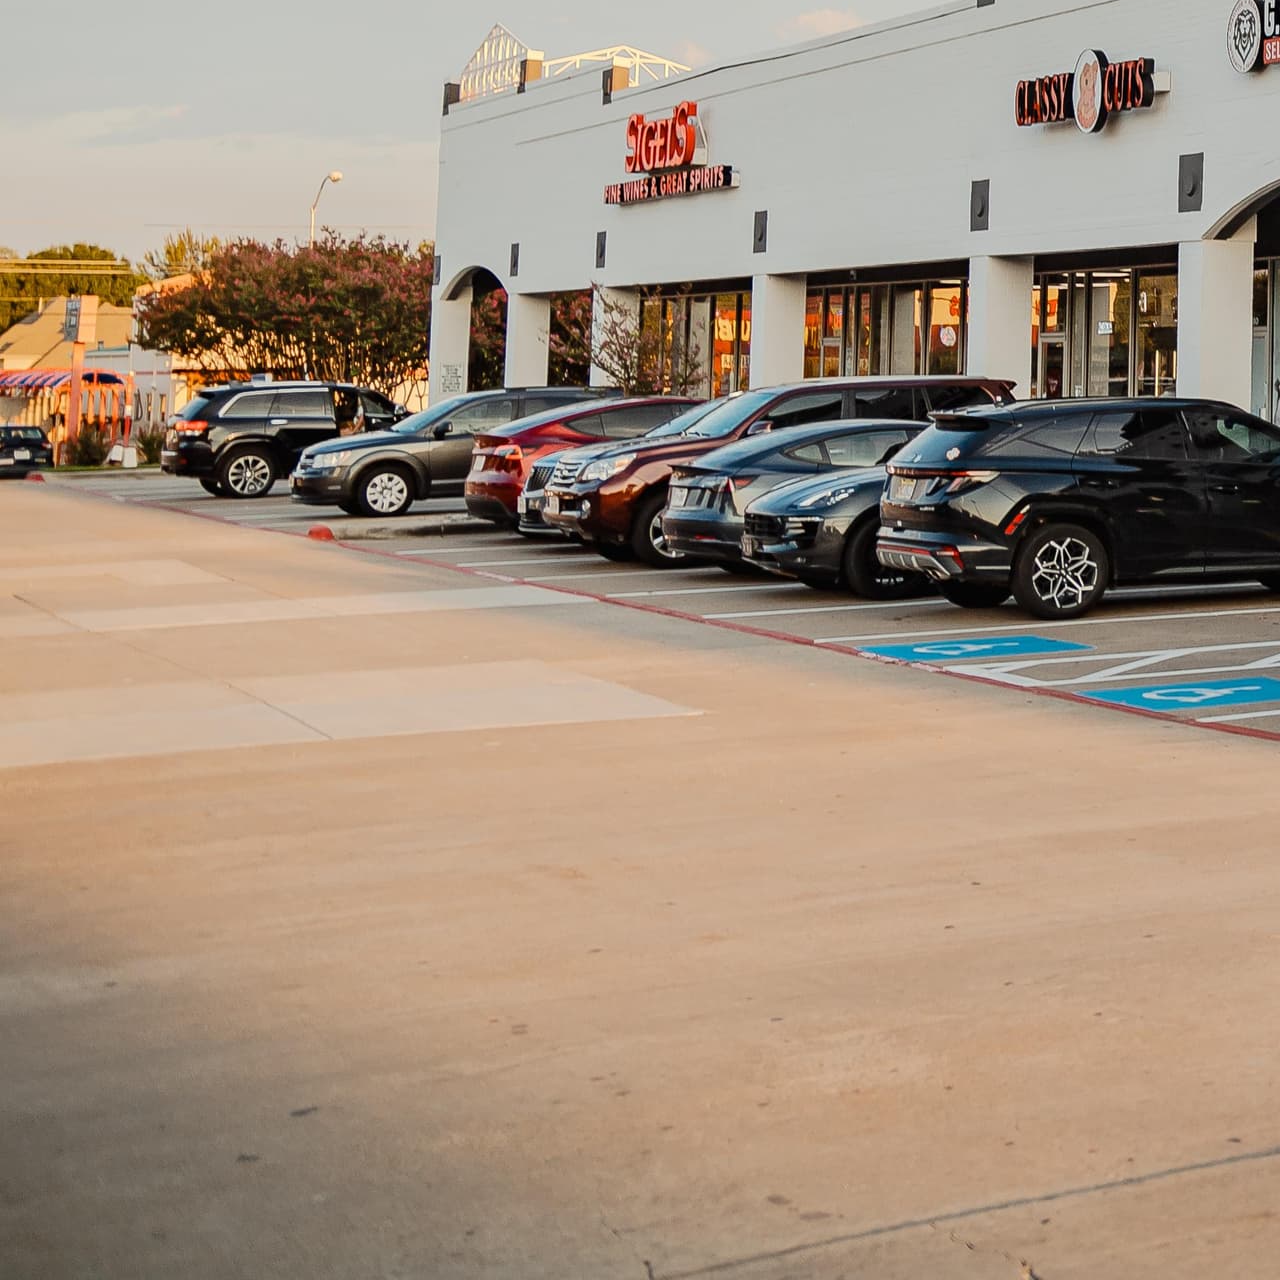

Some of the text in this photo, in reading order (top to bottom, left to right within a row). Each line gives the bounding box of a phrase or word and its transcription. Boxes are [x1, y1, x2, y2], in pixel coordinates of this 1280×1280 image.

[1015, 57, 1145, 126] CLASSY CUTS
[604, 165, 724, 204] FINE WINES & GREAT SPIRITS
